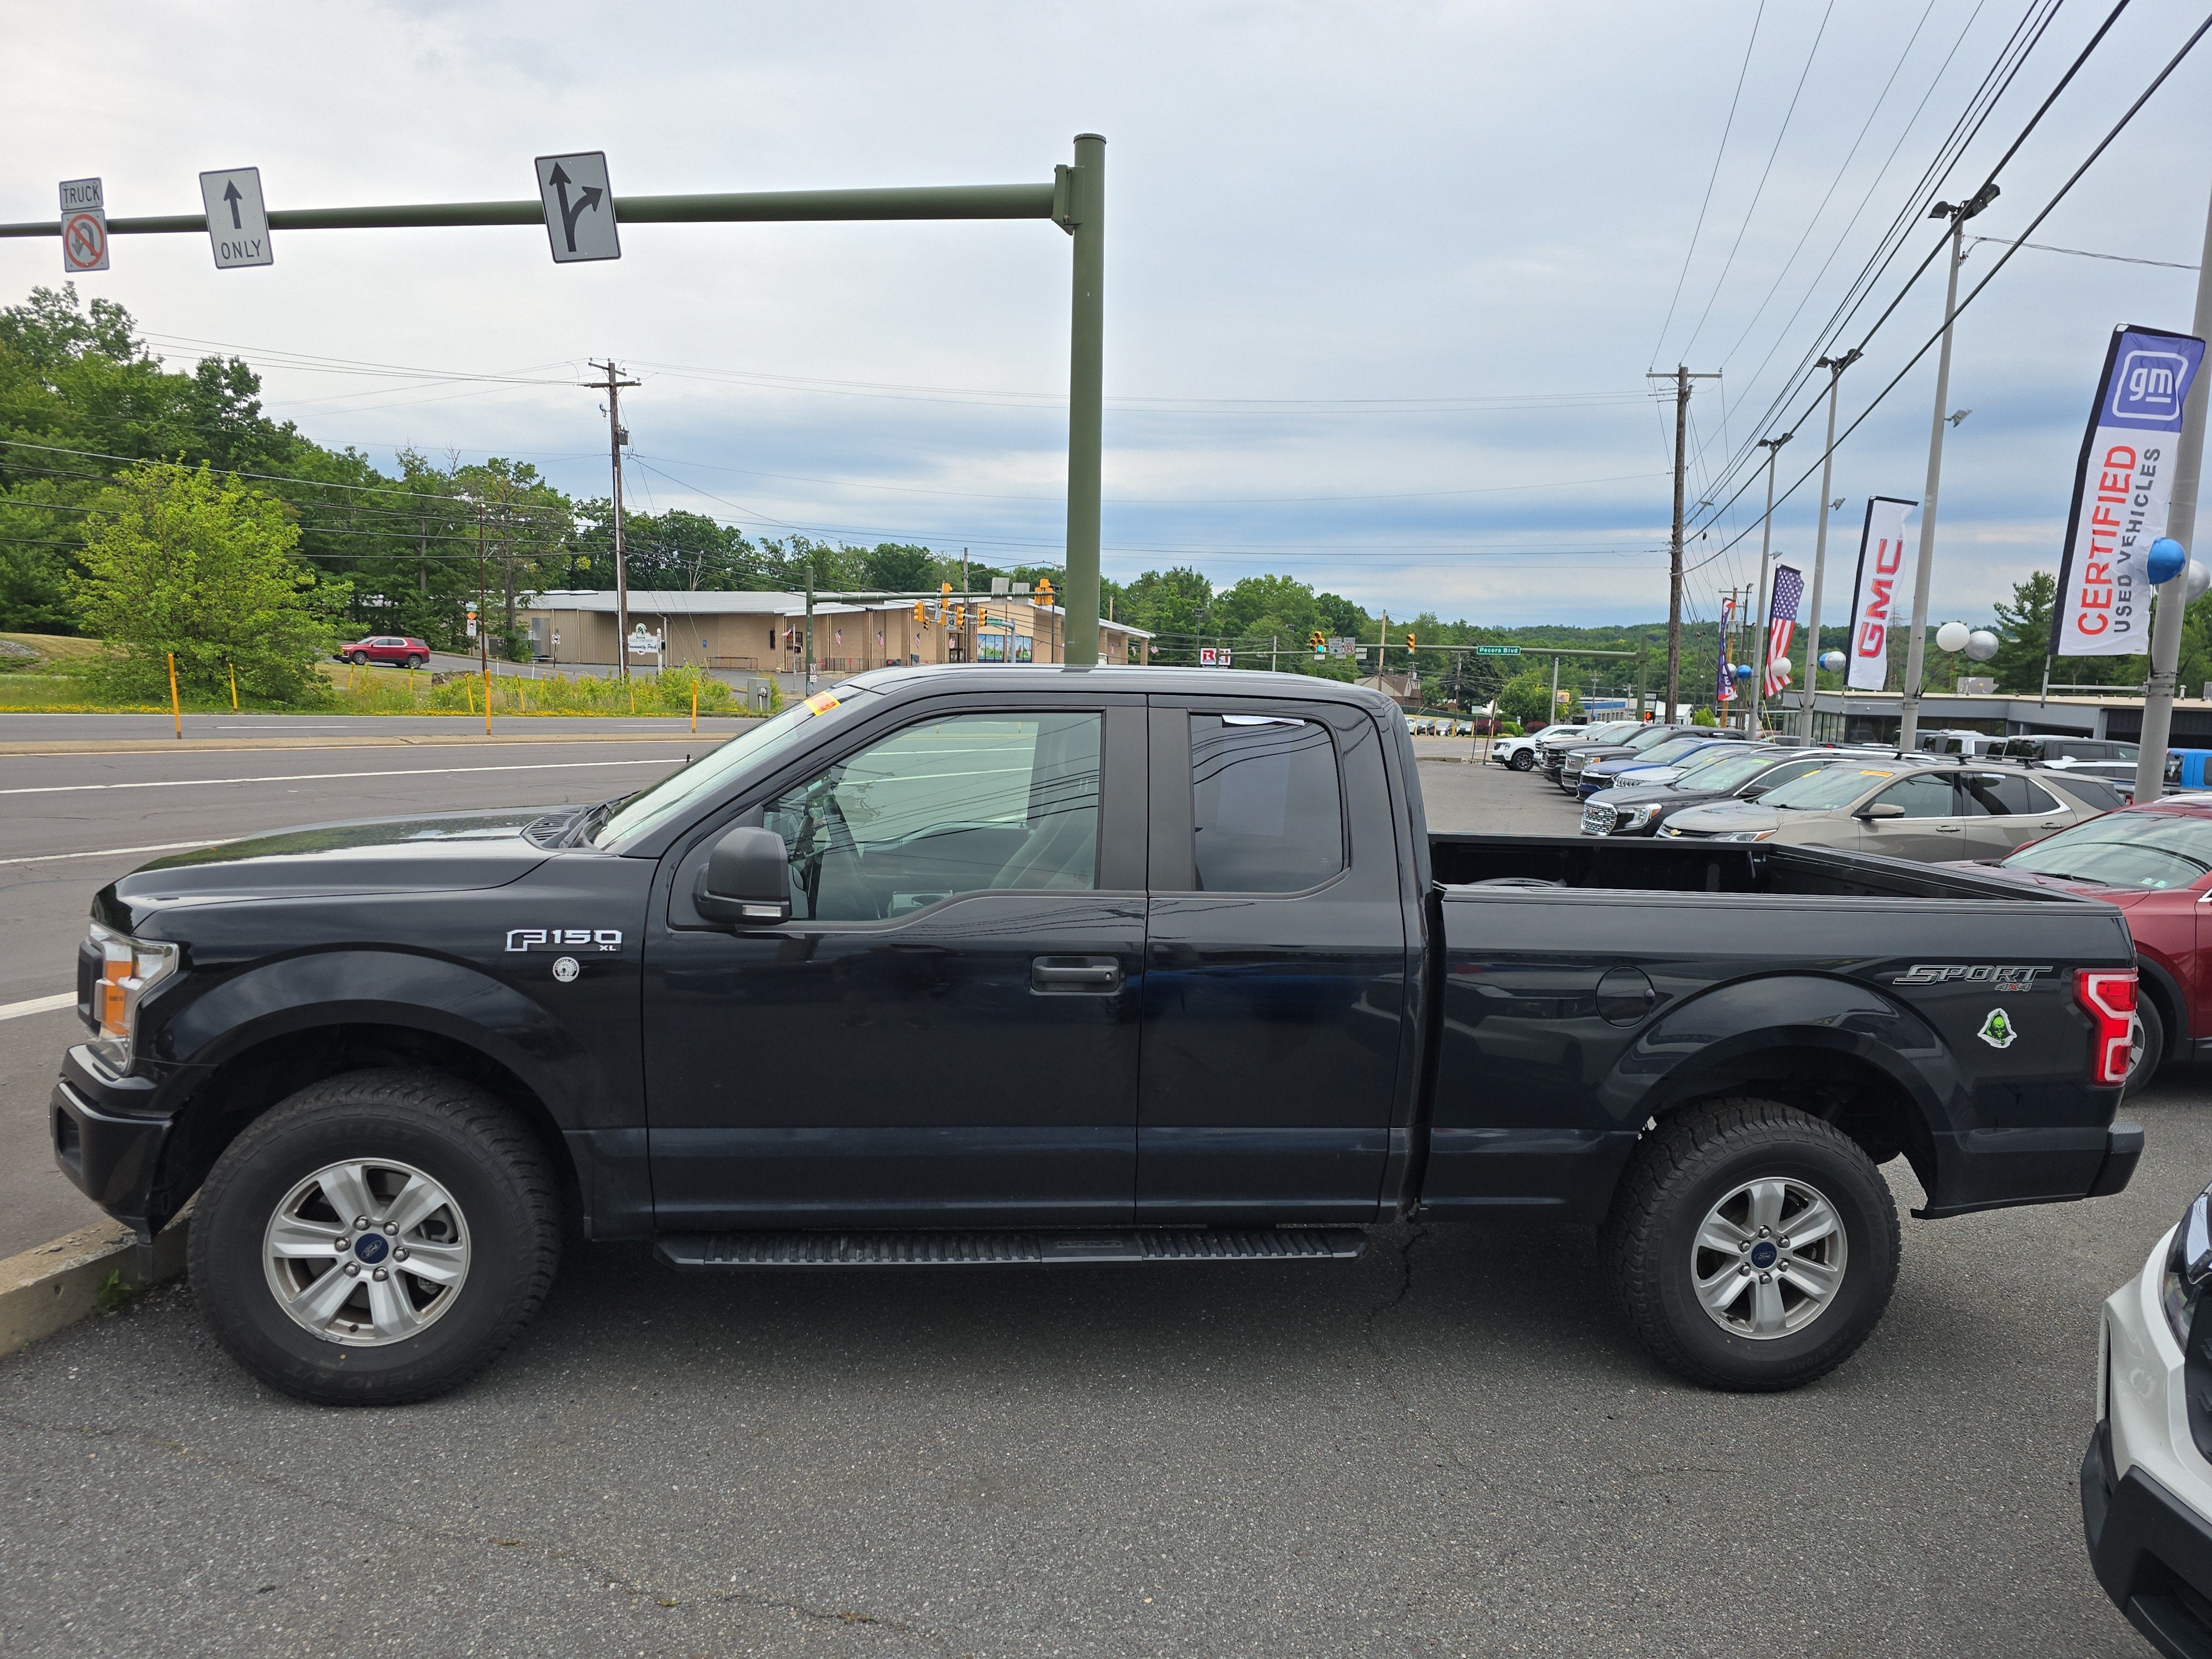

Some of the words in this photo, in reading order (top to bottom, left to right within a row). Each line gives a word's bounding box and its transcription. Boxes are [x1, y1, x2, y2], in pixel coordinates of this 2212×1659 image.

[63, 184, 100, 204] TRUCK
[221, 239, 261, 259] ONLY
[2129, 368, 2172, 403] gm
[2117, 448, 2160, 564] VEHICLES
[2078, 446, 2137, 635] CERTIFIED
[1858, 539, 1903, 658] GMC
[2114, 575, 2132, 632] USED
[1892, 964, 2053, 985] SPORT
[364, 1243, 378, 1256] Ford
